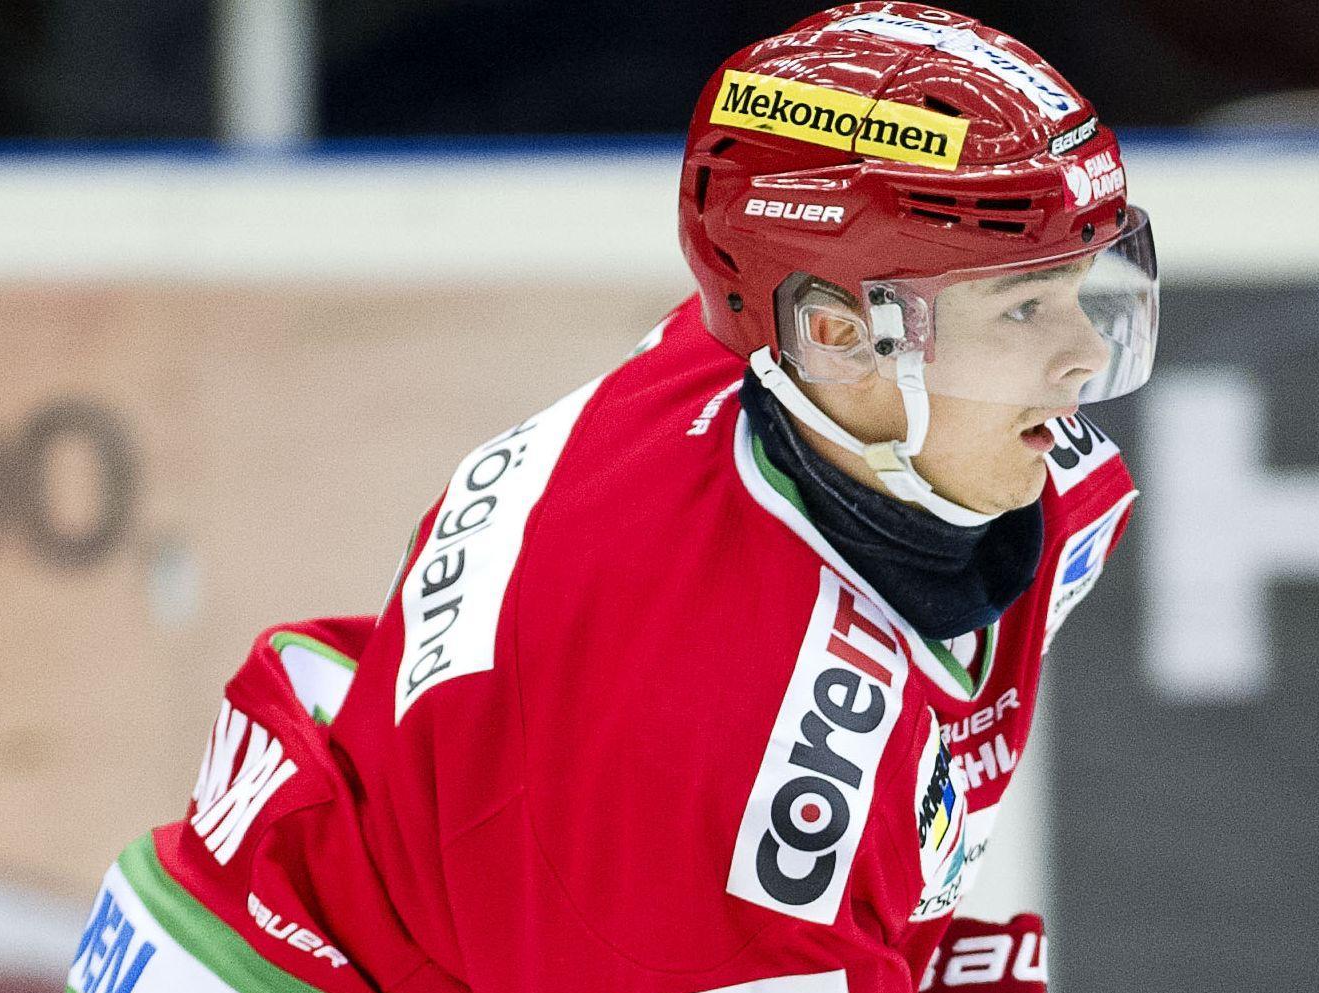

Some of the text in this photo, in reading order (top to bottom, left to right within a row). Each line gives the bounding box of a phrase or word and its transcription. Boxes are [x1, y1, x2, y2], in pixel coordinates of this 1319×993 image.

[721, 82, 948, 157] Mekonomen
[1051, 117, 1097, 155] BAUER
[744, 198, 845, 224] BAUER
